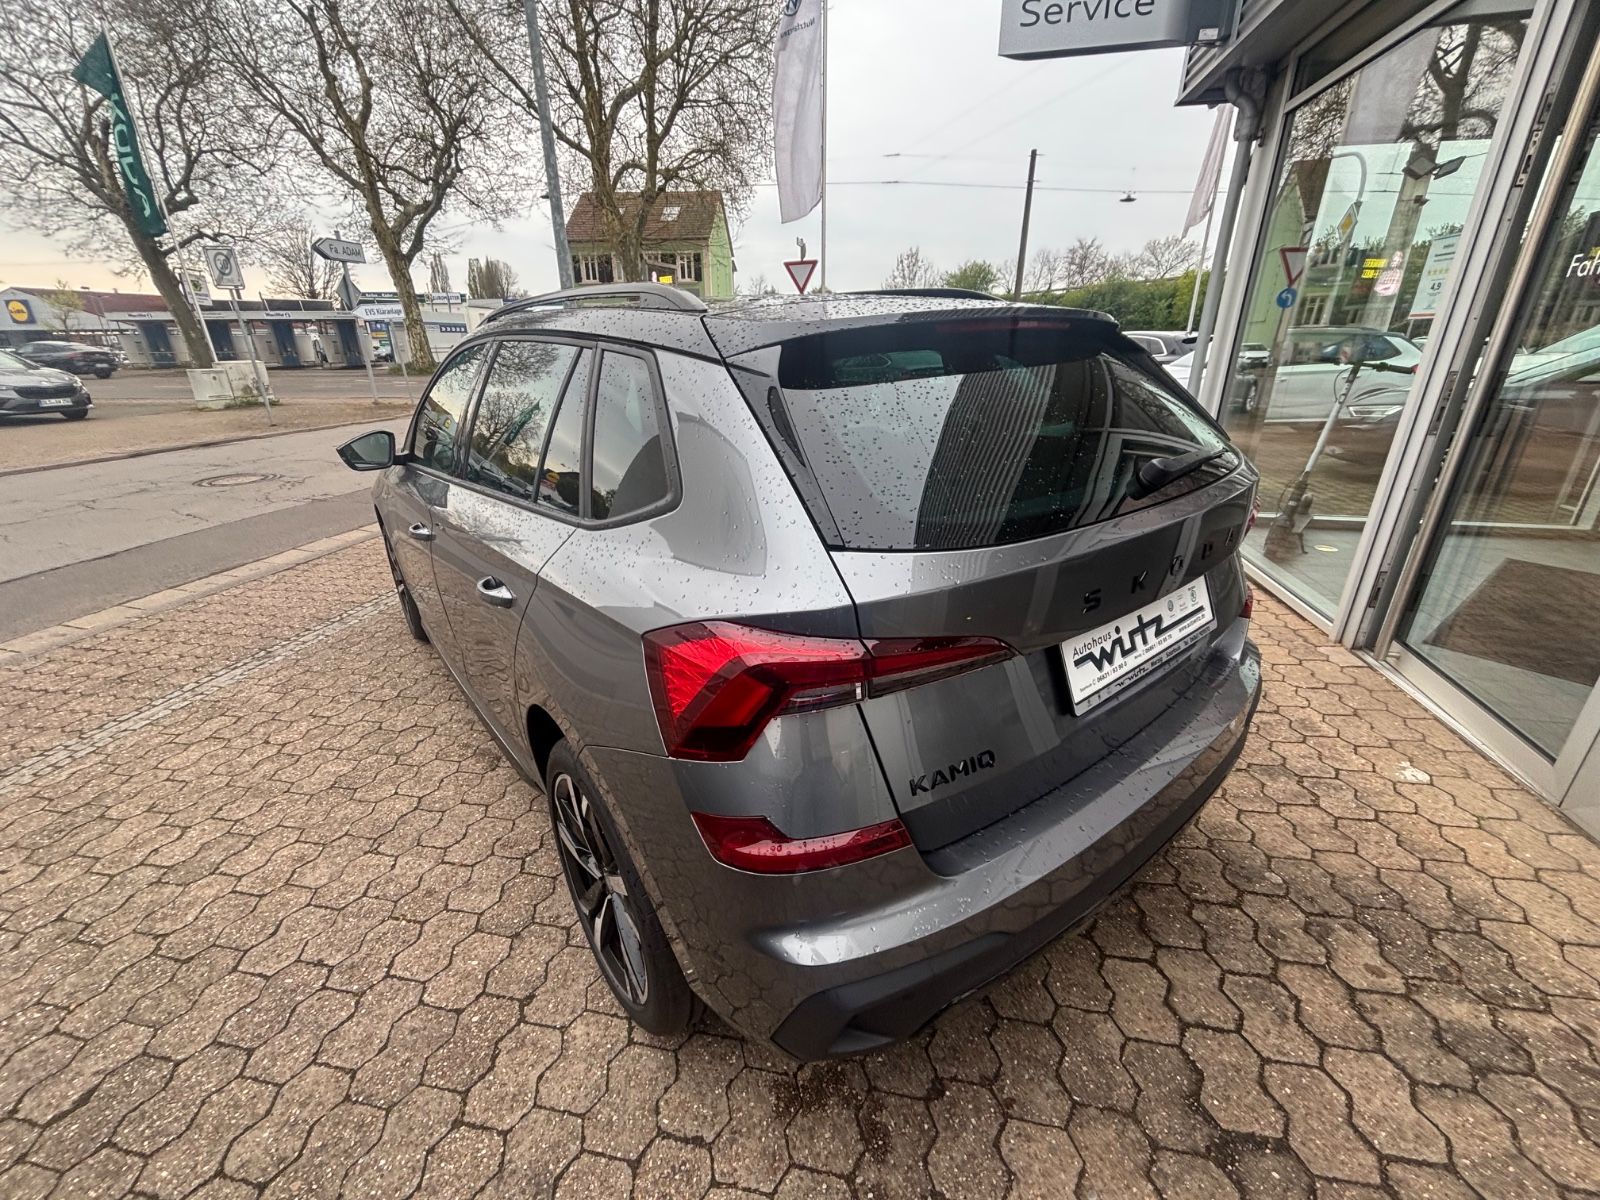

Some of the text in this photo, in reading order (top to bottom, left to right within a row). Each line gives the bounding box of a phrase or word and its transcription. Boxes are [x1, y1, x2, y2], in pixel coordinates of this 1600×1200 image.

[1019, 0, 1154, 27] Service
[328, 243, 362, 257] Fa. ADAM
[217, 257, 229, 271] 30
[1072, 630, 1112, 660] Autohaus
[909, 749, 996, 797] KAMIQ
